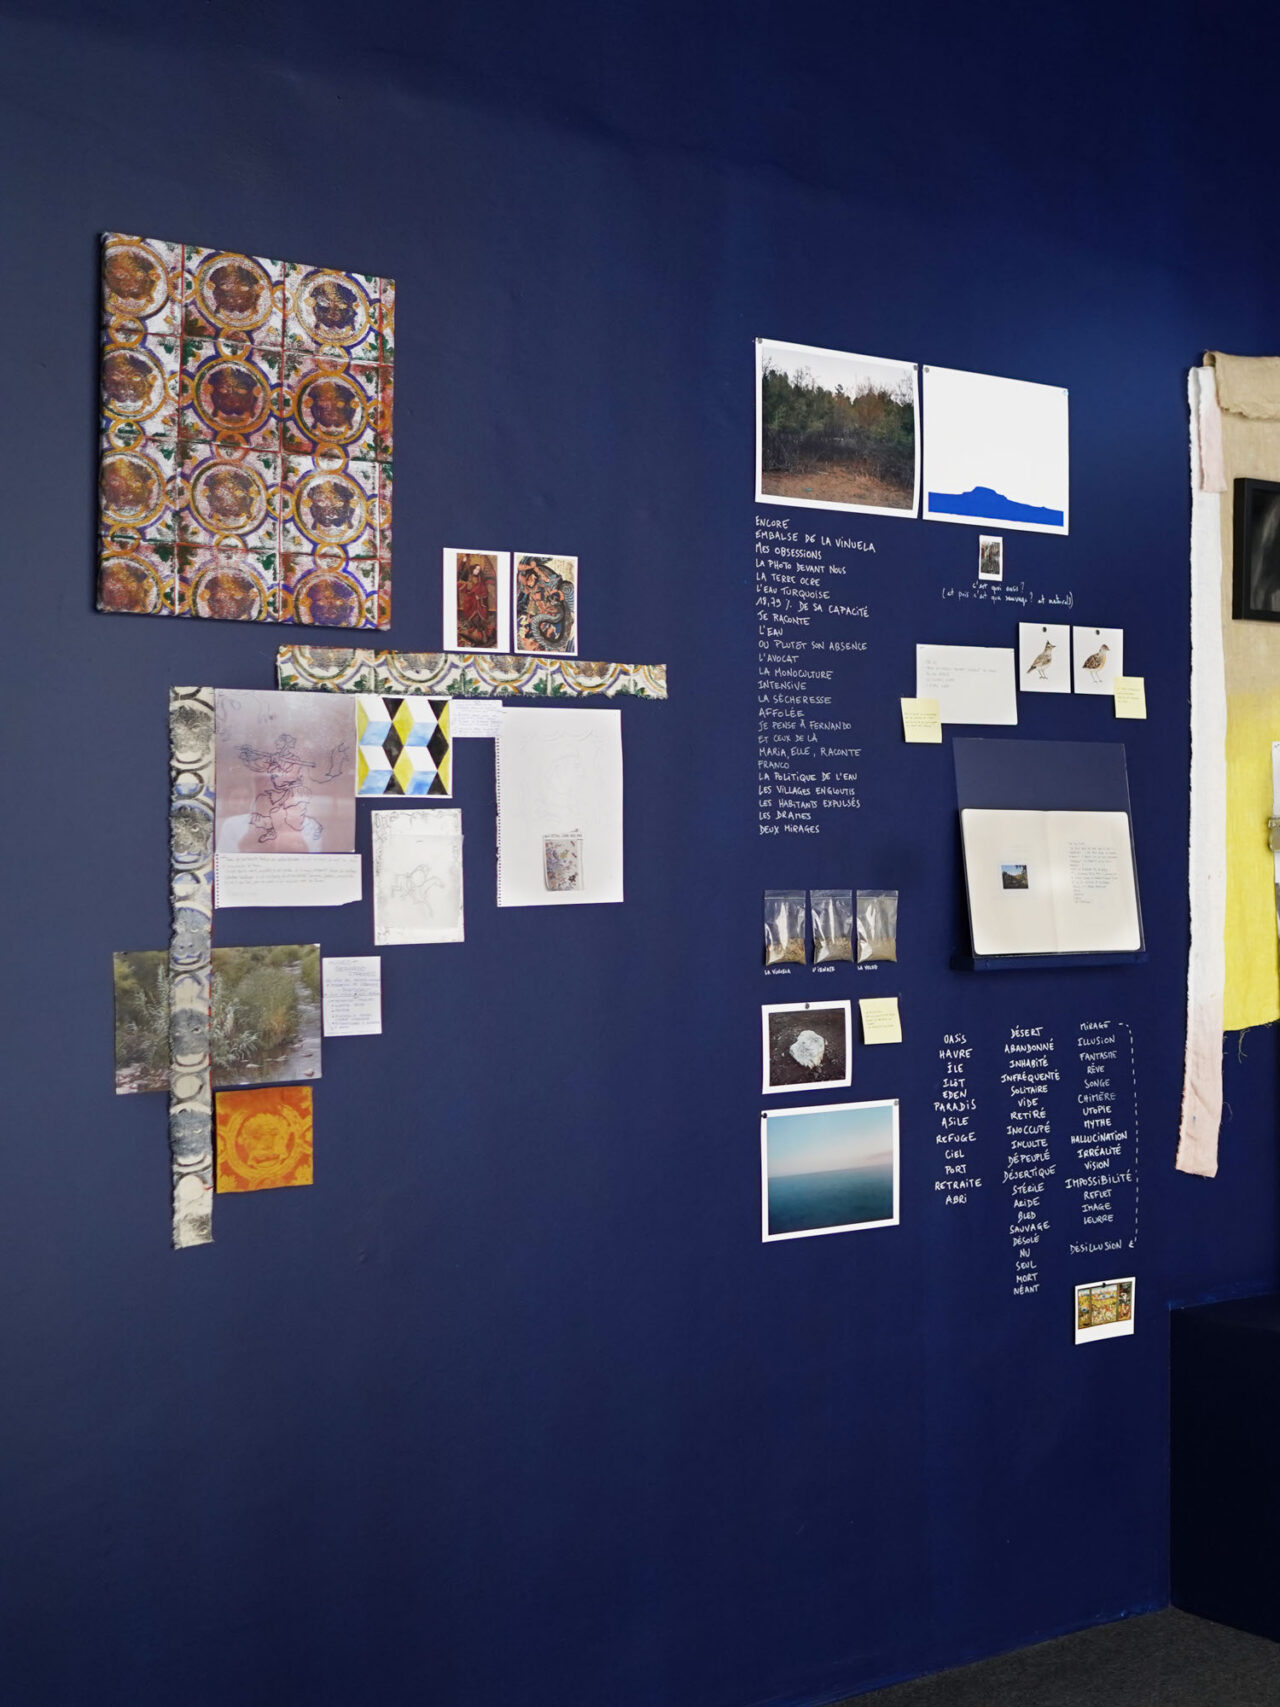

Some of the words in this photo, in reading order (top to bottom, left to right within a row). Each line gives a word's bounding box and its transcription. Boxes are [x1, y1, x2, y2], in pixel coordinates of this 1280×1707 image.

[755, 515, 790, 529] ENCORE
[755, 529, 798, 541] EMBALSE
[805, 534, 816, 543] DE
[821, 536, 832, 546] LA
[756, 542, 770, 554] MES
[775, 547, 822, 560] OBSESSIONS
[756, 558, 765, 568] LA
[768, 559, 791, 570] PHOTO
[796, 562, 825, 573] DEVANT
[829, 564, 846, 574] NOUS
[756, 572, 767, 582] LA
[771, 573, 796, 583] TERRE
[800, 577, 820, 586] OCRE
[756, 584, 777, 594] L'EAU
[780, 586, 830, 600] TURQUOISE
[798, 601, 808, 612] DE
[813, 603, 823, 612] SA
[828, 605, 869, 617] CAPACITÉ
[757, 610, 768, 621] JE
[772, 613, 810, 625] RACONTE
[759, 625, 783, 637] L'EAU
[758, 640, 769, 649] OU
[774, 640, 807, 650] PLUTÔT
[811, 641, 824, 649] SON
[829, 641, 867, 651] ABSENCE
[759, 653, 799, 663] L'AVOCAT
[759, 667, 770, 676] LA
[775, 667, 833, 680] MONOCULTURE
[758, 680, 806, 690] INTENSIVE
[758, 694, 770, 703] LA
[773, 693, 831, 704] SÉCHERESSE
[759, 707, 804, 718] AFFOLÉE
[758, 721, 768, 732] JE
[772, 721, 796, 729] PENSE
[809, 721, 851, 731] FERNANDO
[758, 735, 768, 744] ET
[795, 734, 804, 742] DE
[807, 733, 817, 742] LÀ
[820, 747, 861, 757] RACONTE
[758, 760, 789, 769] FRANCO
[759, 773, 770, 781] LA
[774, 771, 817, 783] POLITIQUE
[822, 772, 831, 781] DE
[836, 772, 857, 781] L'EAU
[758, 785, 772, 795] LES
[776, 785, 811, 795] VILLAGES
[815, 786, 855, 795] ENGLOUTIS
[759, 799, 772, 807] LES
[779, 799, 817, 809] HABITANTS
[823, 797, 860, 808] EXPULSÉS
[759, 812, 771, 820] LES
[775, 810, 811, 820] DRAMES
[759, 825, 779, 835] DEUX
[784, 824, 820, 833] MIRAGES
[1080, 1021, 1111, 1030] MIRAGE
[1011, 1025, 1043, 1039] DÉSERT
[944, 1033, 967, 1044] OASIS
[1078, 1034, 1115, 1046] ILLUSION
[1004, 1038, 1054, 1054] ABANDONNÉ
[939, 1048, 973, 1059] HAVRE
[1079, 1050, 1117, 1061] FANTASME
[1009, 1055, 1048, 1068] INHABITÉ
[1087, 1063, 1104, 1074] RÊVE
[1001, 1069, 1060, 1083] INFRÉQUENTÉ
[1084, 1079, 1110, 1089] SONGE
[942, 1088, 967, 1100] EDEN
[1011, 1085, 1048, 1097] SOLITAIRE
[1018, 1097, 1038, 1107] VIDE
[1078, 1091, 1116, 1104] CHIMÈRE
[933, 1099, 976, 1112] PARADIS
[1083, 1105, 1112, 1116] UTOPIE
[1010, 1108, 1046, 1120] RETIRÉ
[942, 1117, 969, 1129] ASILE
[1006, 1121, 1050, 1135] INOCCUPÉ
[1084, 1118, 1112, 1129] MYTHE
[936, 1132, 976, 1144] REFUGE
[1071, 1130, 1127, 1144] HALLUCINATION
[1011, 1139, 1048, 1149] INCULTE
[945, 1149, 965, 1159] CIEL
[1077, 1143, 1121, 1158] IRRÉALITÉ
[1007, 1149, 1052, 1168] DÉPEUPLÉ
[1084, 1158, 1109, 1171] VISION
[945, 1164, 966, 1175] PORT
[1002, 1162, 1056, 1183] DÉSERTIQUE
[935, 1178, 982, 1191] RETRAITE
[1065, 1169, 1132, 1189] IMPOSSIBILITÉ
[1012, 1182, 1044, 1196] STÉRILE
[1084, 1189, 1112, 1200] REFLET
[945, 1194, 967, 1205] ABRI
[1014, 1196, 1040, 1208] ARIDE
[1081, 1202, 1112, 1212] IMAGE
[1018, 1211, 1036, 1223] BLED
[1084, 1214, 1114, 1224] LEURRE
[1009, 1221, 1050, 1234] SAUVAGE
[1013, 1233, 1039, 1247] DÉSOLÉ
[1020, 1248, 1030, 1258] NU
[1070, 1239, 1122, 1255] DÉSILLUSION
[1016, 1260, 1037, 1271] SEUL
[1016, 1272, 1038, 1283] MORT
[1013, 1284, 1040, 1295] NÉANT
